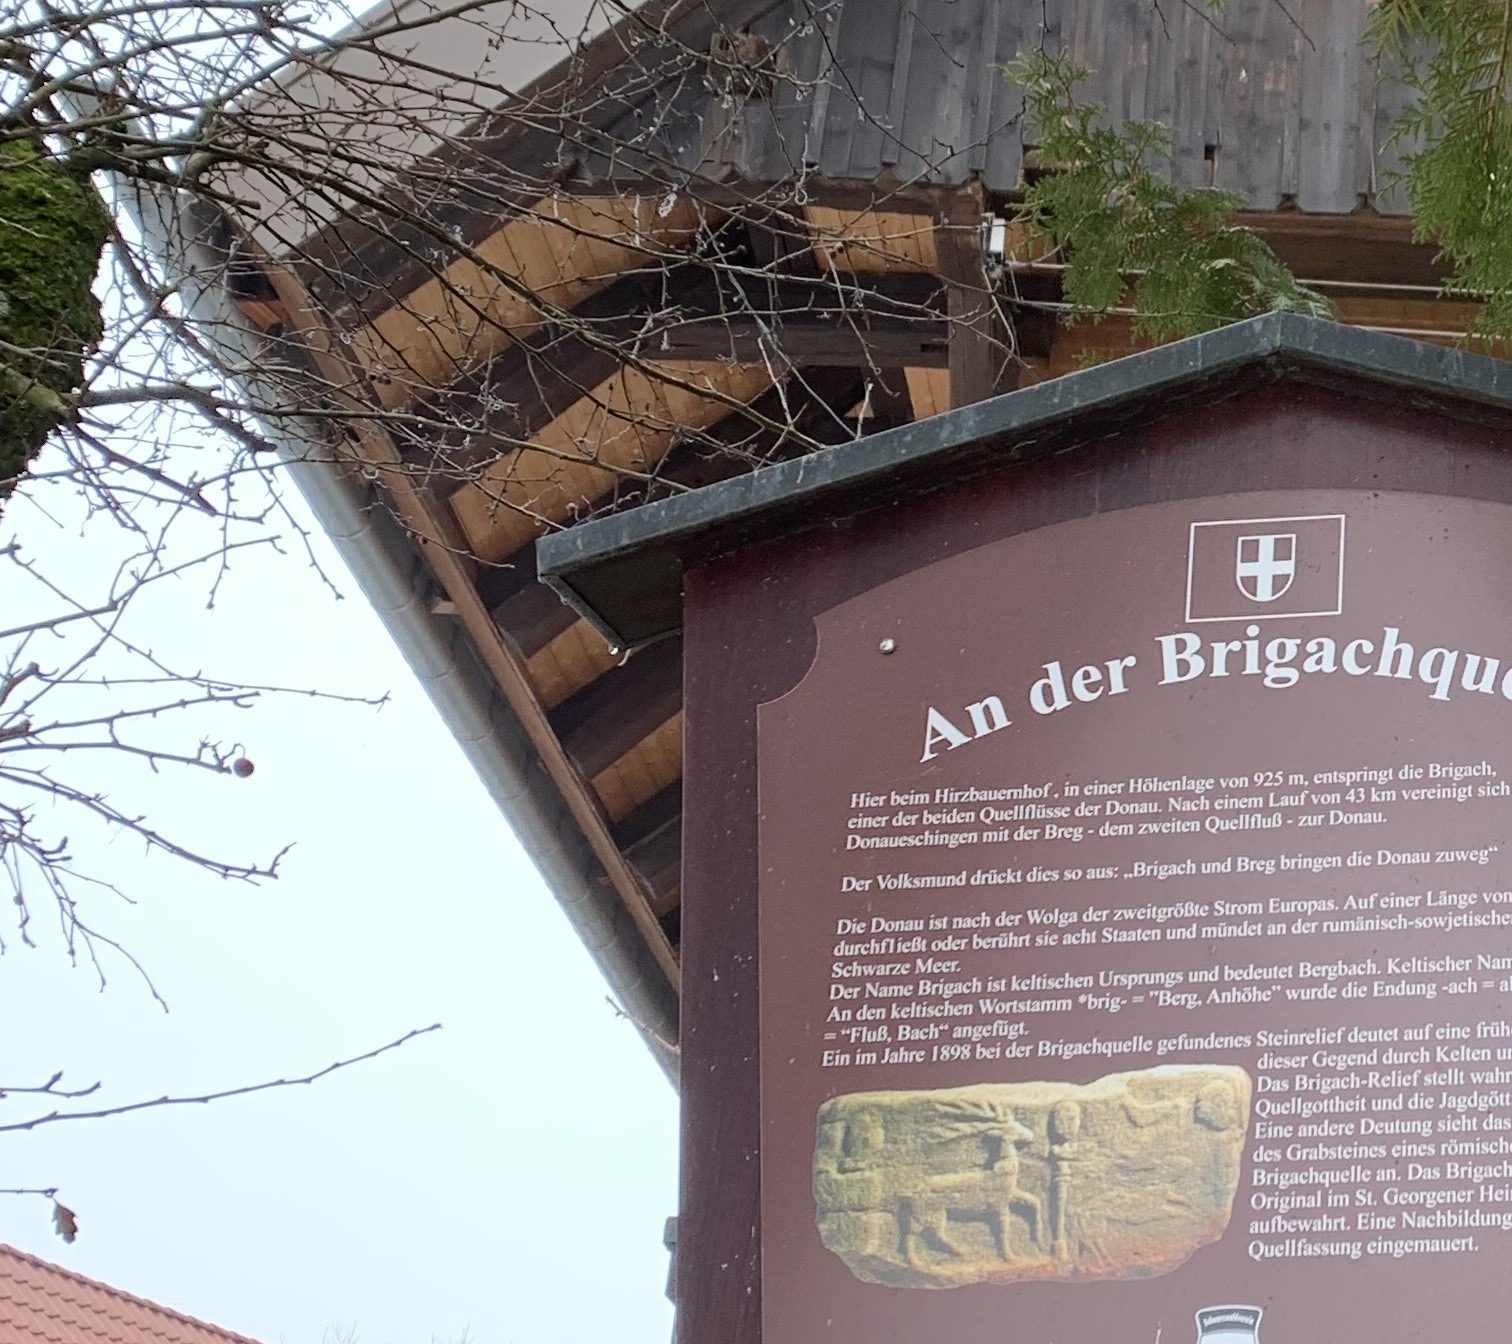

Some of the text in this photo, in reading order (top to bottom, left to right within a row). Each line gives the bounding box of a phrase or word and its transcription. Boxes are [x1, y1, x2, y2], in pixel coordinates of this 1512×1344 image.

[919, 696, 1012, 763] An
[1030, 655, 1137, 715] der
[847, 812, 890, 829] einer
[892, 810, 920, 827] der
[922, 807, 976, 825] beiden
[979, 803, 1071, 825] Quellflüsse
[1074, 800, 1102, 817] der
[1105, 799, 1163, 816] Donau.
[1168, 794, 1210, 812] Nach
[1214, 793, 1264, 810] einem
[1269, 789, 1307, 808] Lauf
[1311, 792, 1341, 805] von
[1345, 786, 1366, 803] 43
[1371, 786, 1397, 802] km
[1401, 782, 1473, 802] vereinigt
[1477, 779, 1510, 797] sich
[846, 809, 1387, 850] Donaueschingen mit der Breg dem zweiten Quellfluß zur Donau.
[841, 875, 873, 892] Der
[877, 869, 967, 890] Volksmund
[970, 867, 1022, 886] drückt
[1026, 865, 1060, 883] dies
[1063, 868, 1083, 881] so
[1086, 866, 1119, 880] aus:
[1201, 856, 1232, 874] und
[1236, 856, 1276, 875] Breg
[1280, 852, 1342, 873] bringen
[1346, 849, 1372, 867] die
[1377, 849, 1431, 865] Donau
[836, 917, 867, 935] Die
[870, 916, 924, 933] Donau
[928, 913, 948, 930] ist
[952, 910, 991, 929] nach
[994, 910, 1023, 927] der
[1027, 907, 1078, 928] Wolga
[1082, 905, 1110, 923] der
[1113, 900, 1210, 923] zweitgrößte
[1213, 899, 1263, 916] Strom
[1268, 897, 1339, 916] Europas.
[1343, 892, 1376, 911] Auf
[1380, 891, 1422, 909] einer
[1427, 889, 1478, 910] Länge
[1482, 890, 1512, 904] von
[830, 983, 861, 1000] Der
[864, 981, 914, 998] Name
[918, 976, 982, 999] Brigach
[986, 975, 1007, 993] ist
[1011, 971, 1094, 991] keltischen
[1099, 969, 1184, 990] Ursprungs
[1188, 964, 1220, 983] und
[1224, 963, 1293, 982] bedeutet
[1299, 957, 1381, 981] Bergbach.
[1387, 954, 1473, 974] Keltischer
[831, 956, 962, 978] Schwarze Meer.
[822, 1048, 851, 1067] Ein
[855, 1047, 877, 1065] im
[880, 1045, 926, 1064] Jahre
[932, 1043, 971, 1062] 1898
[975, 1041, 1001, 1060] bei
[1005, 1040, 1034, 1059] der
[1037, 1035, 1153, 1060] Brigachquelle
[1156, 1032, 1252, 1056] gefundenes
[1256, 1027, 1343, 1047] Steinrelief
[1347, 1026, 1398, 1043] deutet
[1403, 1023, 1431, 1041] auf
[1435, 1022, 1471, 1040] eine
[1257, 1051, 1309, 1070] dieser
[1312, 1047, 1378, 1071] Gegend
[1382, 1045, 1430, 1065] durch
[1436, 1044, 1491, 1063] Kelten
[1257, 1075, 1290, 1093] Das
[1295, 1068, 1420, 1095] Brigach-Relief
[1423, 1067, 1465, 1086] stellt
[1255, 1093, 1366, 1119] Quellgottheit
[1371, 1092, 1403, 1111] und
[1408, 1091, 1435, 1110] die
[1255, 1120, 1294, 1139] Eine
[1297, 1118, 1355, 1138] andere
[1360, 1117, 1433, 1137] Deutung
[1437, 1113, 1478, 1132] sieht
[1482, 1112, 1512, 1131] das
[1252, 1144, 1282, 1163] des
[1286, 1141, 1387, 1161] Grabsteines
[1391, 1139, 1436, 1158] eines
[1252, 1164, 1372, 1190] Brigachquelle
[1376, 1167, 1402, 1181] an.
[1408, 1162, 1441, 1181] Das
[1250, 1189, 1322, 1214] Original
[1327, 1189, 1350, 1207] im
[1355, 1188, 1377, 1206] St.
[1383, 1187, 1475, 1209] Georgener
[1249, 1213, 1351, 1234] aufbewahrt.
[1357, 1212, 1396, 1230] Eine
[1402, 1208, 1512, 1231] Nachbildung
[1248, 1235, 1479, 1262] Quellfassung eingemauert.
